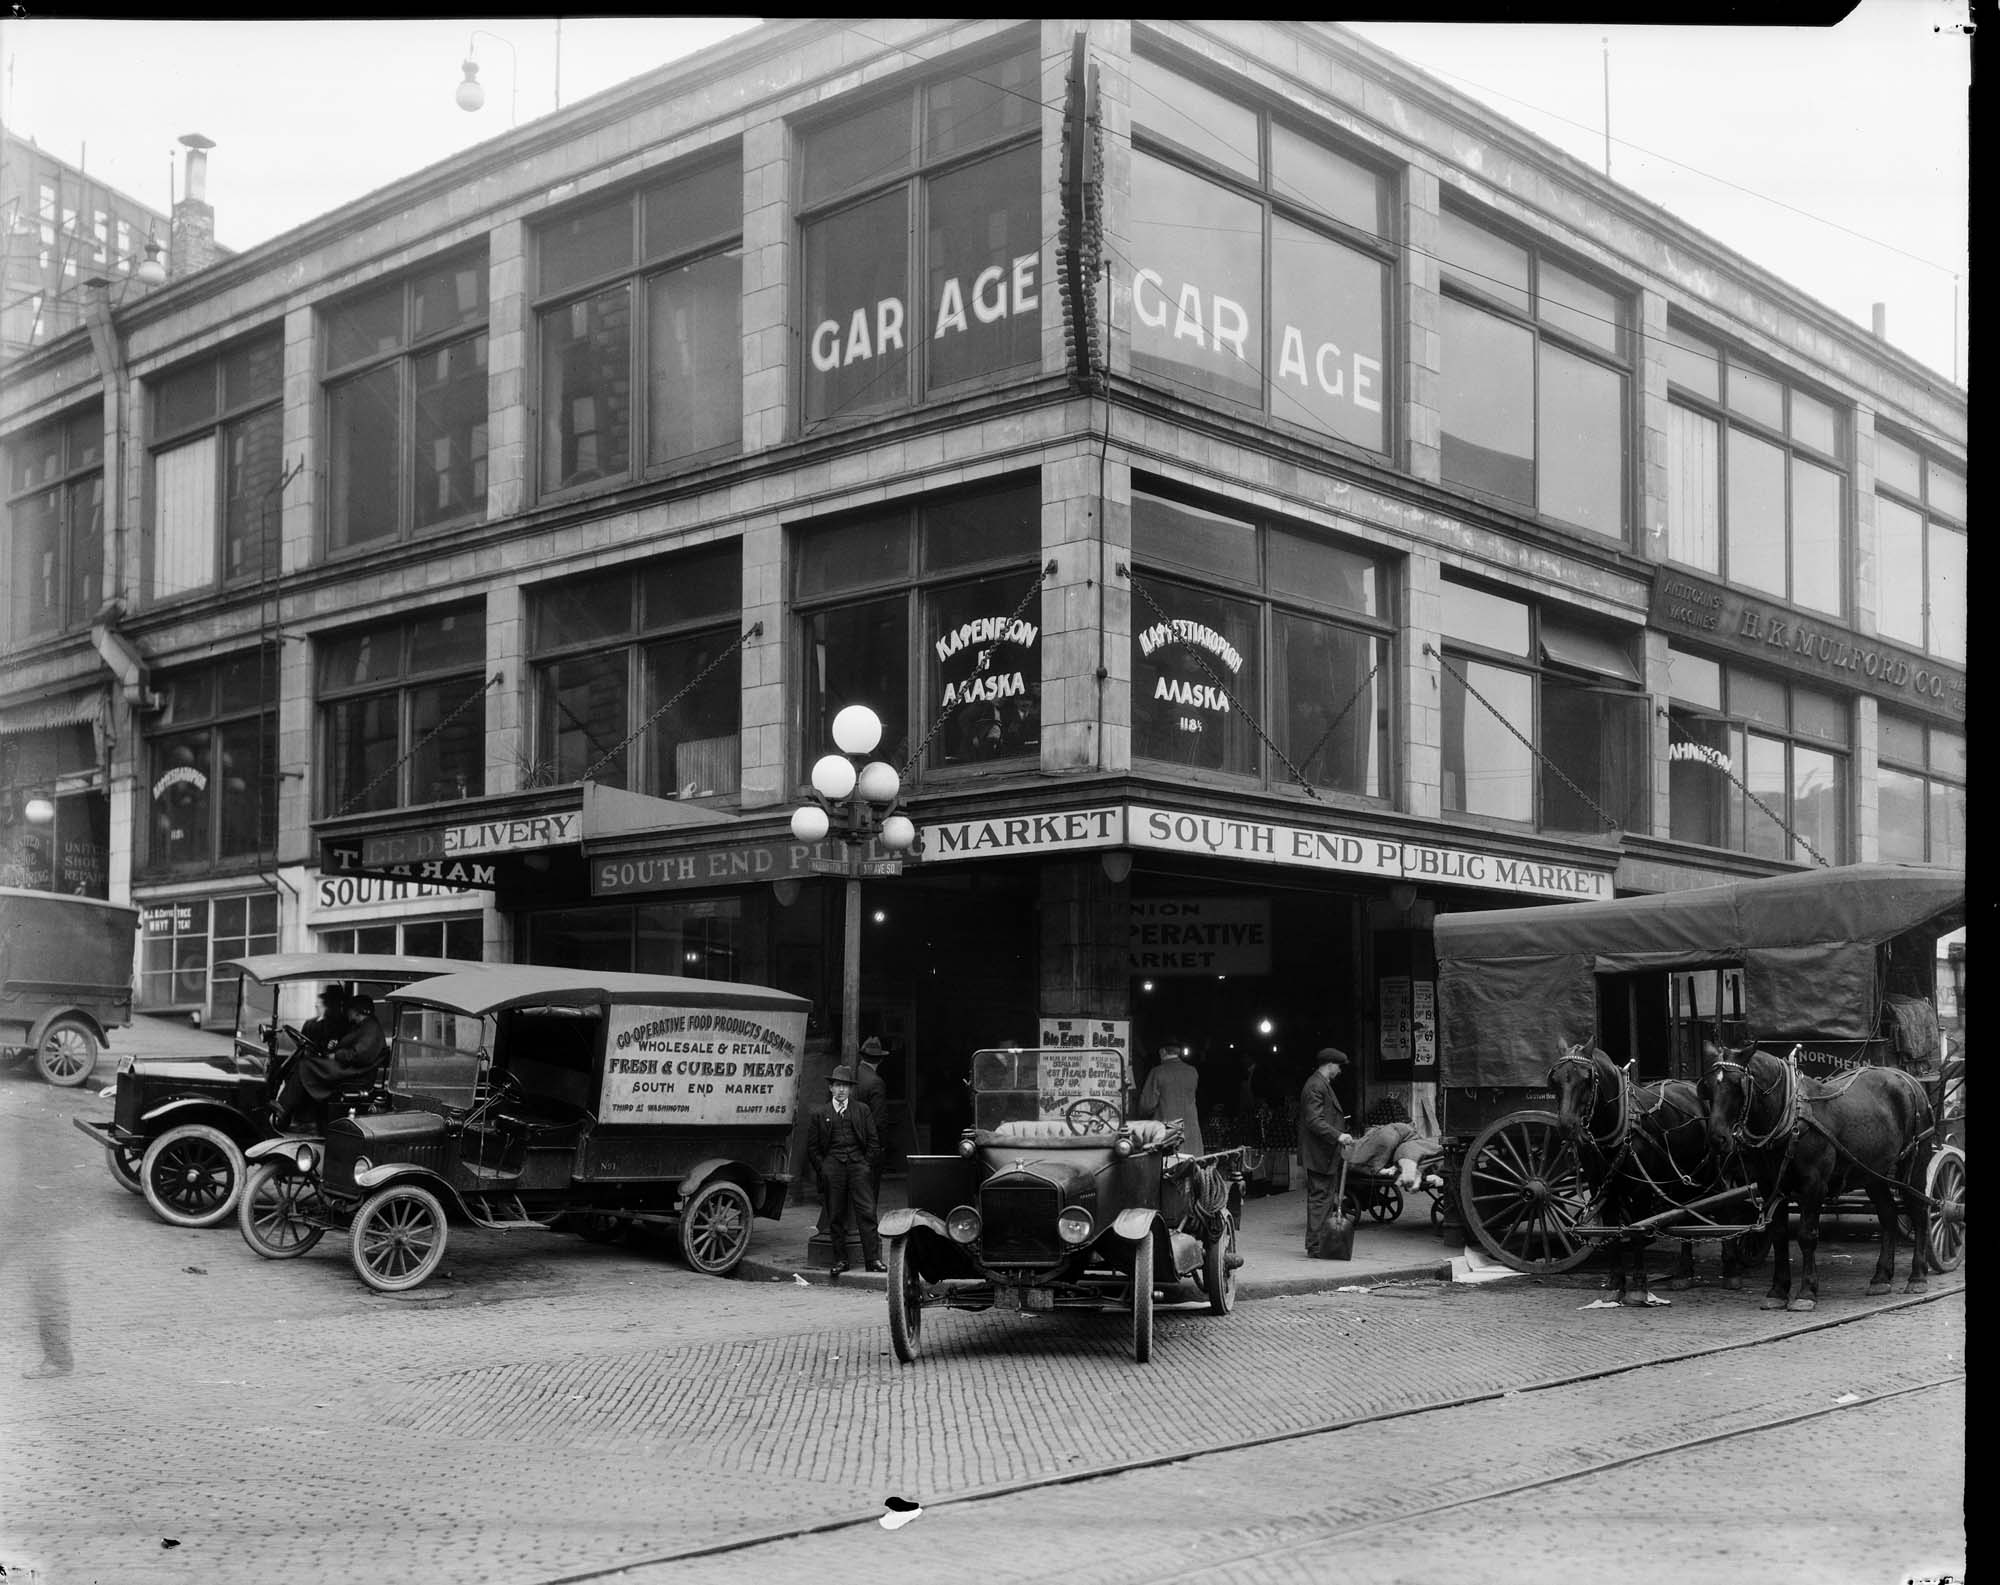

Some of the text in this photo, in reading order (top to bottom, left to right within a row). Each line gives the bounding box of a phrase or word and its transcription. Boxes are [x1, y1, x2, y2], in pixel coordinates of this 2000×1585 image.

[811, 251, 1040, 373] GAR AGE
[1132, 268, 1382, 413] GAR AGE
[1740, 610, 1763, 639] H.
[1768, 619, 1789, 648] K.
[1795, 628, 1907, 687] MULFORD
[1913, 670, 1945, 698] CO.
[601, 856, 696, 888] SOUTH
[708, 848, 773, 877] END
[937, 809, 1117, 854] MARKET
[1149, 812, 1606, 895] SOUTH END PUBLIC MARKET
[616, 1016, 686, 1049] CO-OPERATIVE
[687, 1014, 713, 1031] FOOD
[714, 1015, 762, 1039] PRODUCTS
[638, 1041, 771, 1055] WHOLESALE & RETAIL
[608, 1058, 794, 1077] FRESH & CURED MEATS
[632, 1082, 774, 1095] SOUTH END MARKET
[612, 1103, 634, 1112] THIRD
[647, 1104, 690, 1113] WASHINGTON
